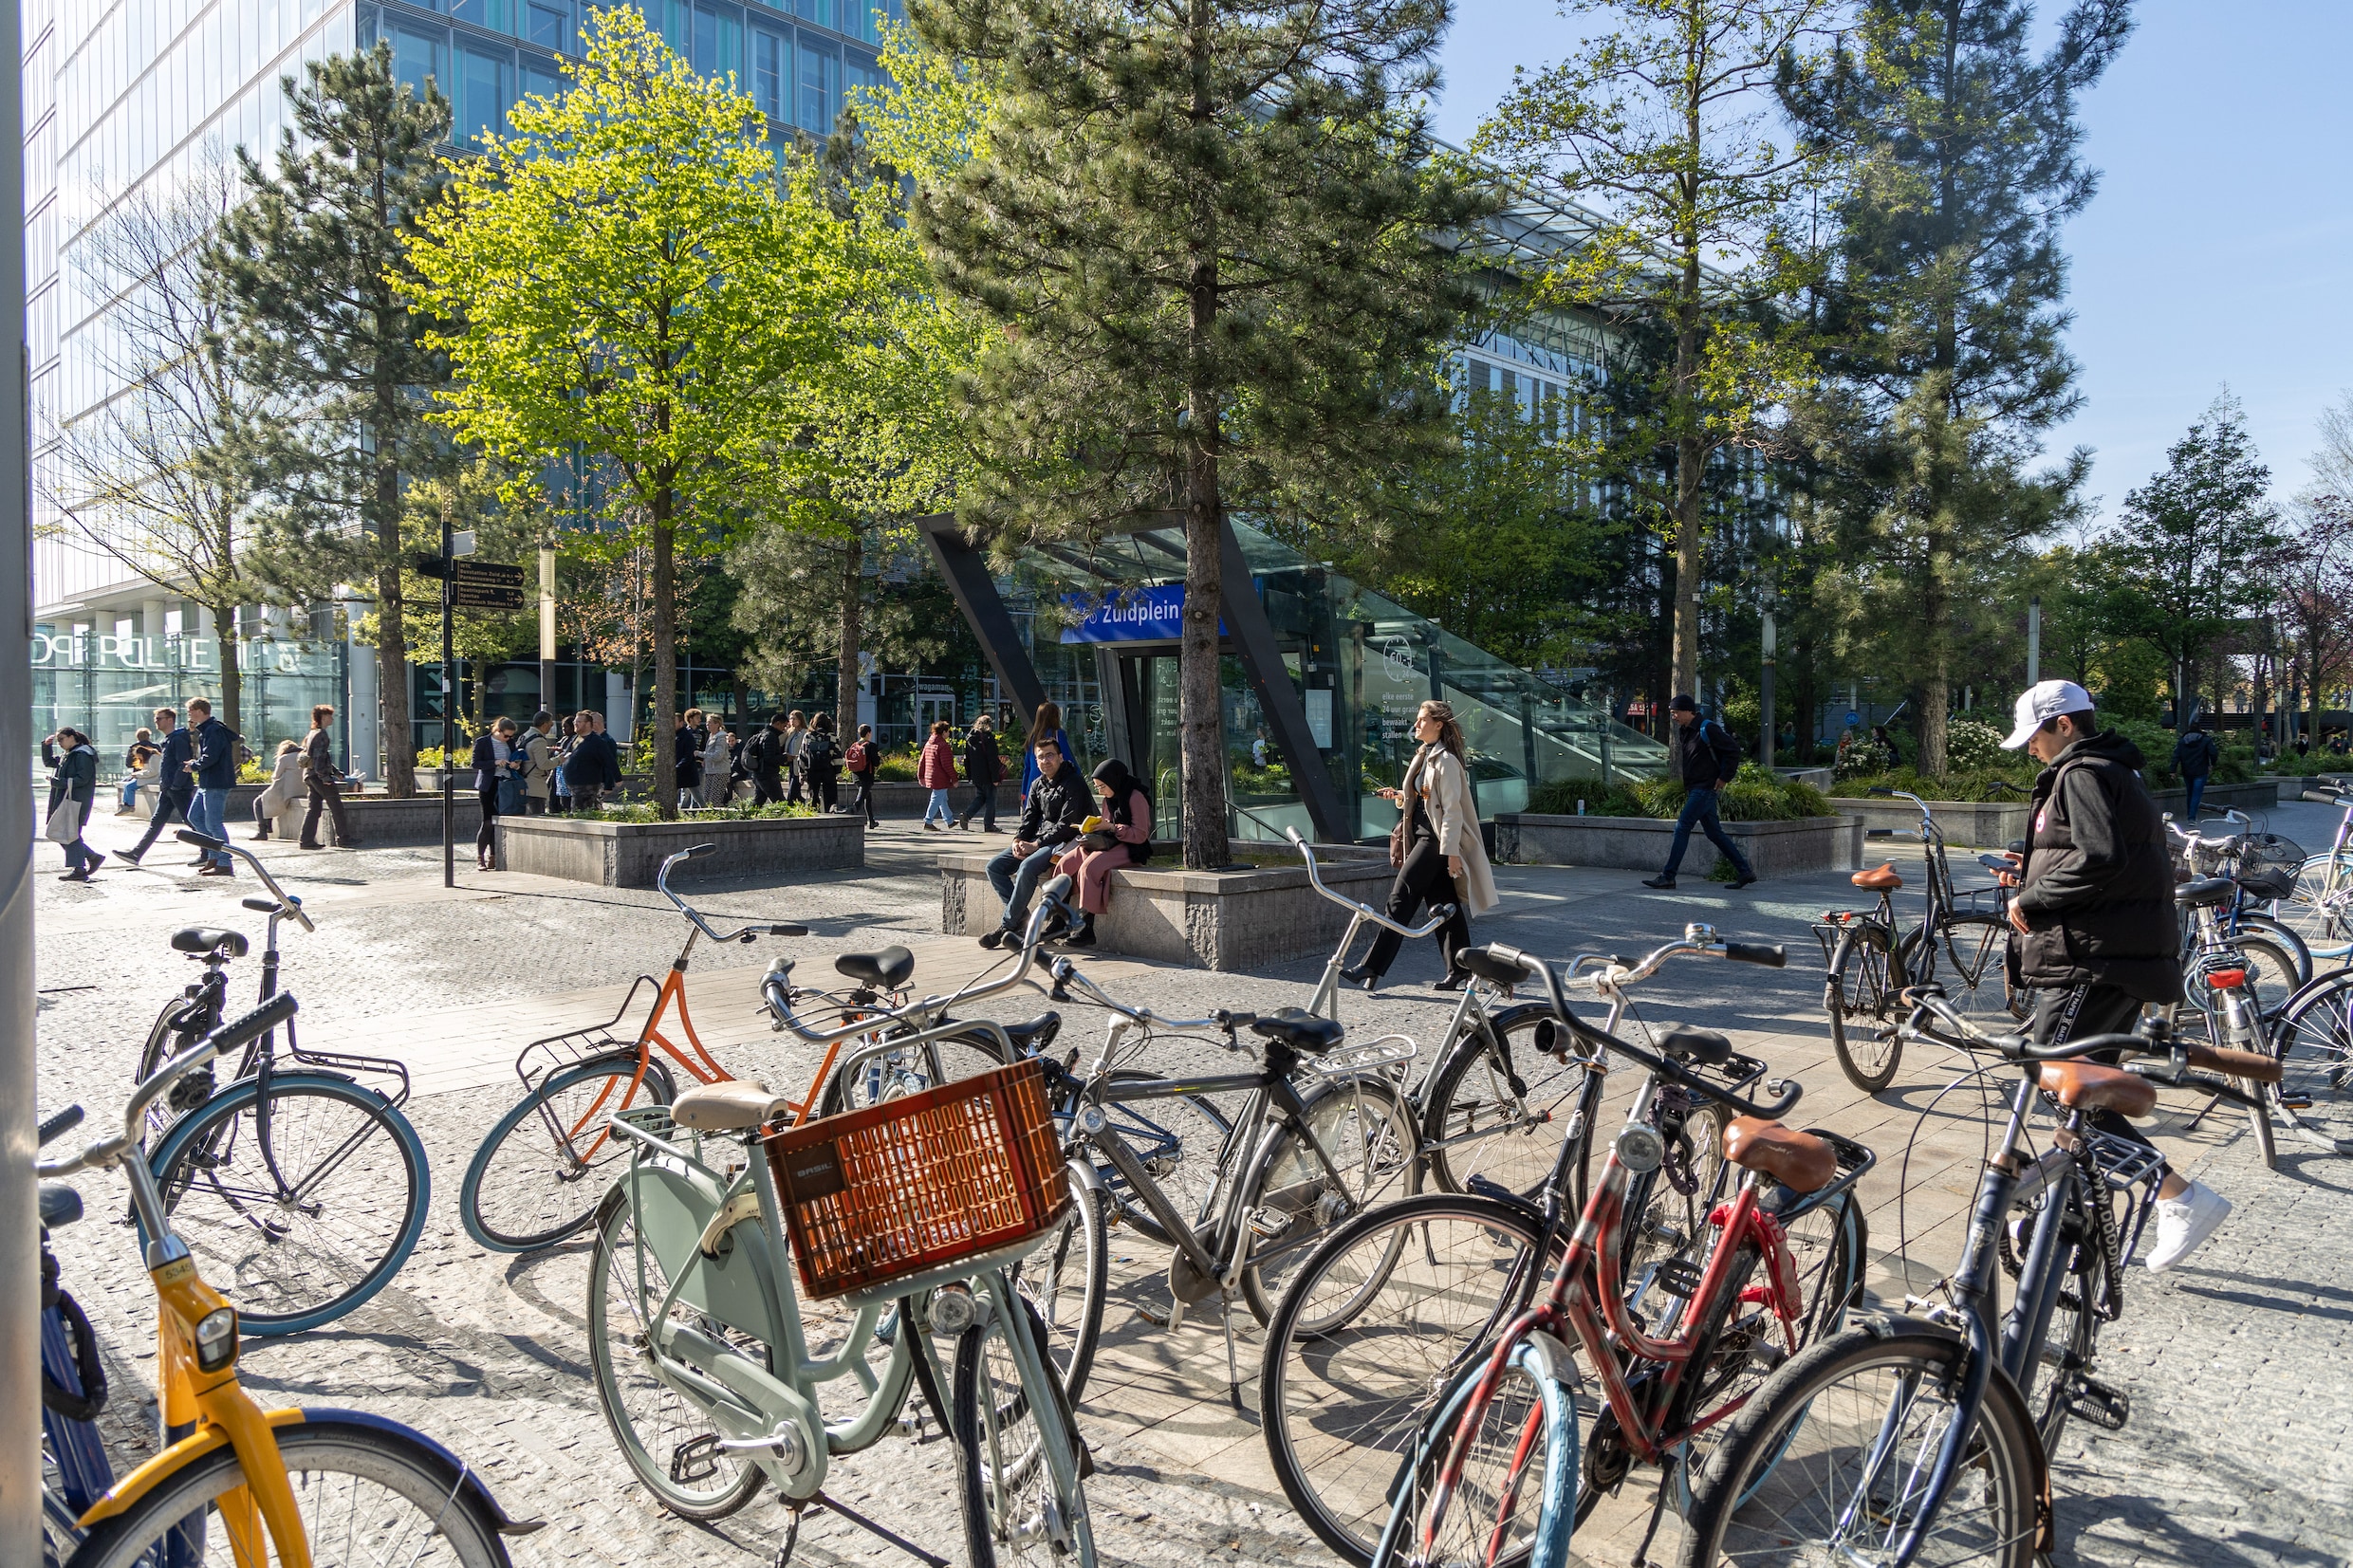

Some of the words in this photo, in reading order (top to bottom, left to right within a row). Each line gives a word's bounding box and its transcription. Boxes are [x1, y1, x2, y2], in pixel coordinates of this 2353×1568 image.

[460, 575, 496, 583] Parnassusweg
[1102, 600, 1179, 626] Zuidplein
[1402, 670, 1409, 678] 24
[1402, 705, 1418, 714] gratis
[2066, 997, 2079, 1017] PAPER
[2057, 1025, 2067, 1042] DAILY
[797, 1163, 833, 1177] BASIL
[317, 1432, 376, 1447] MARATHON
